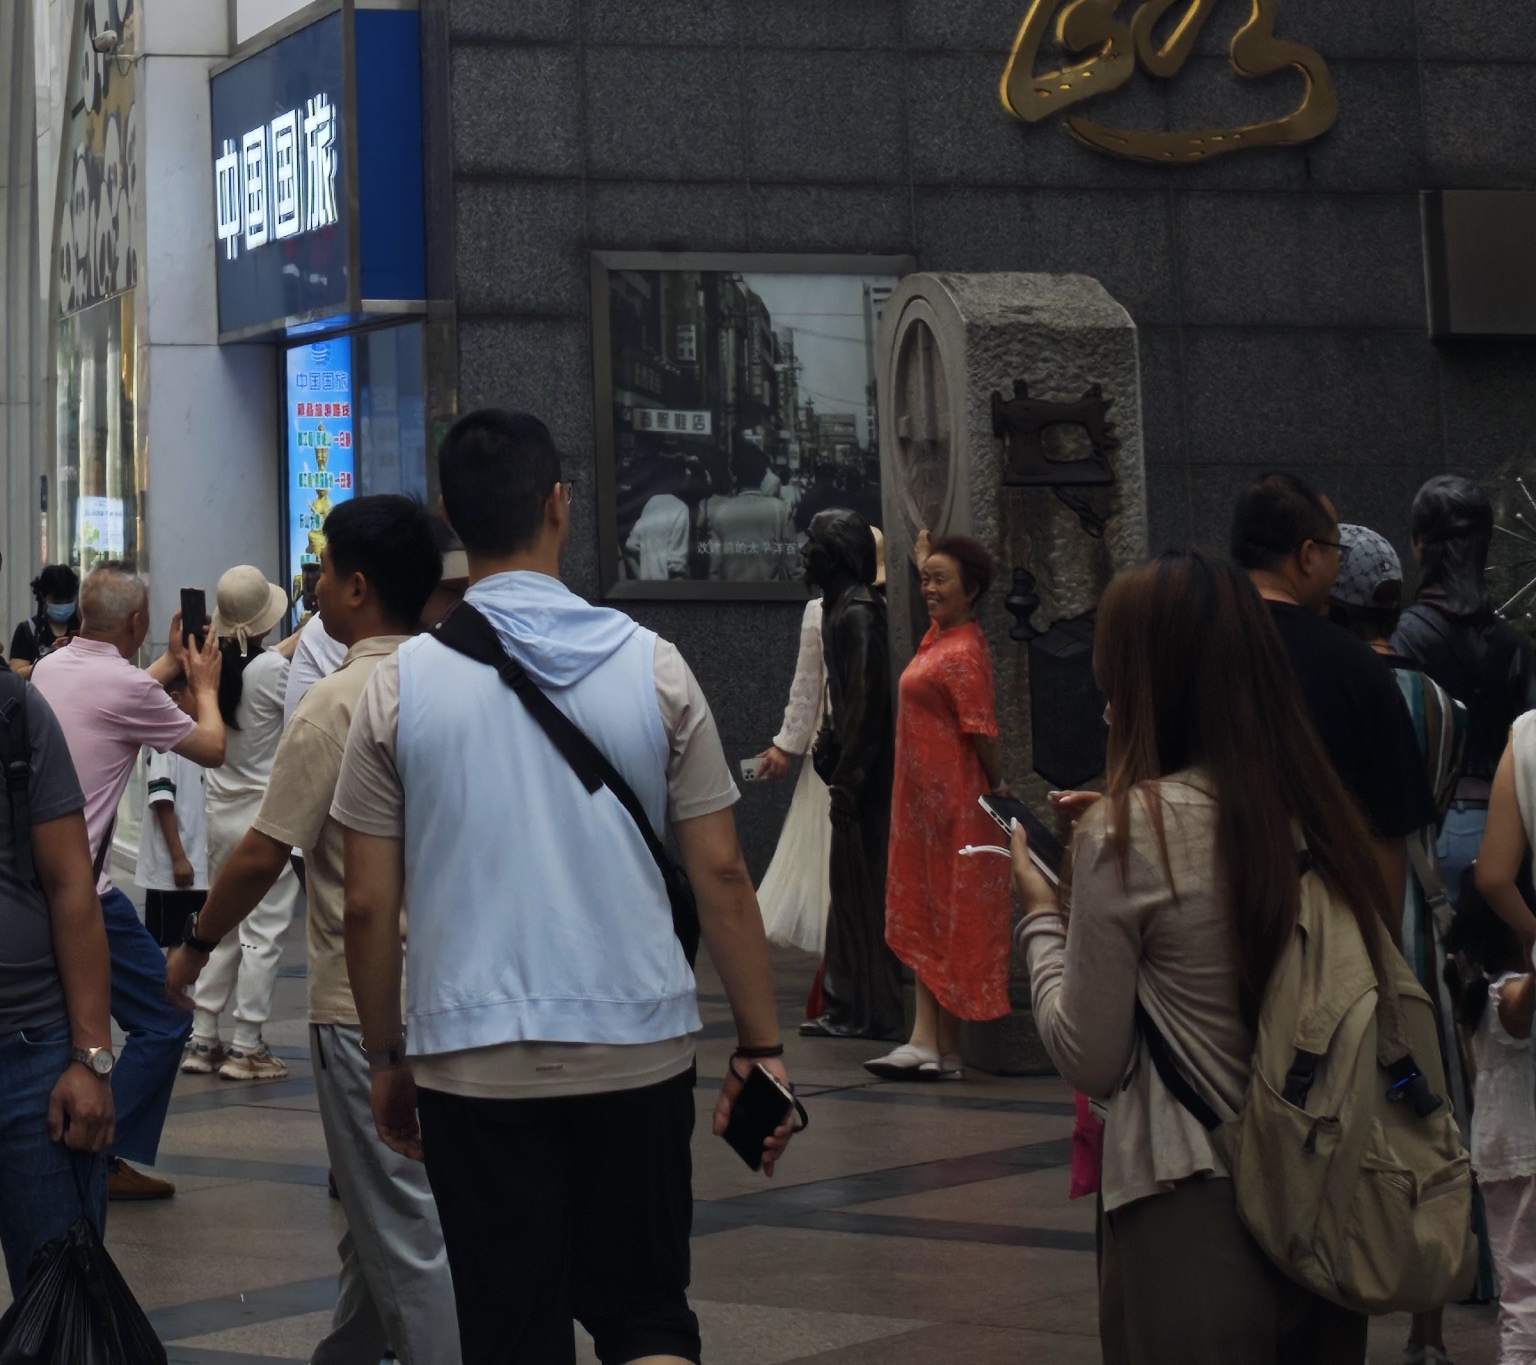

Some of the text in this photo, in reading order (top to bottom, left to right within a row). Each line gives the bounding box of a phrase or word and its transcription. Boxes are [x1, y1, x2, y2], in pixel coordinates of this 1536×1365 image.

[214, 92, 339, 260] 中国国旅
[296, 371, 349, 391] 中国国旅
